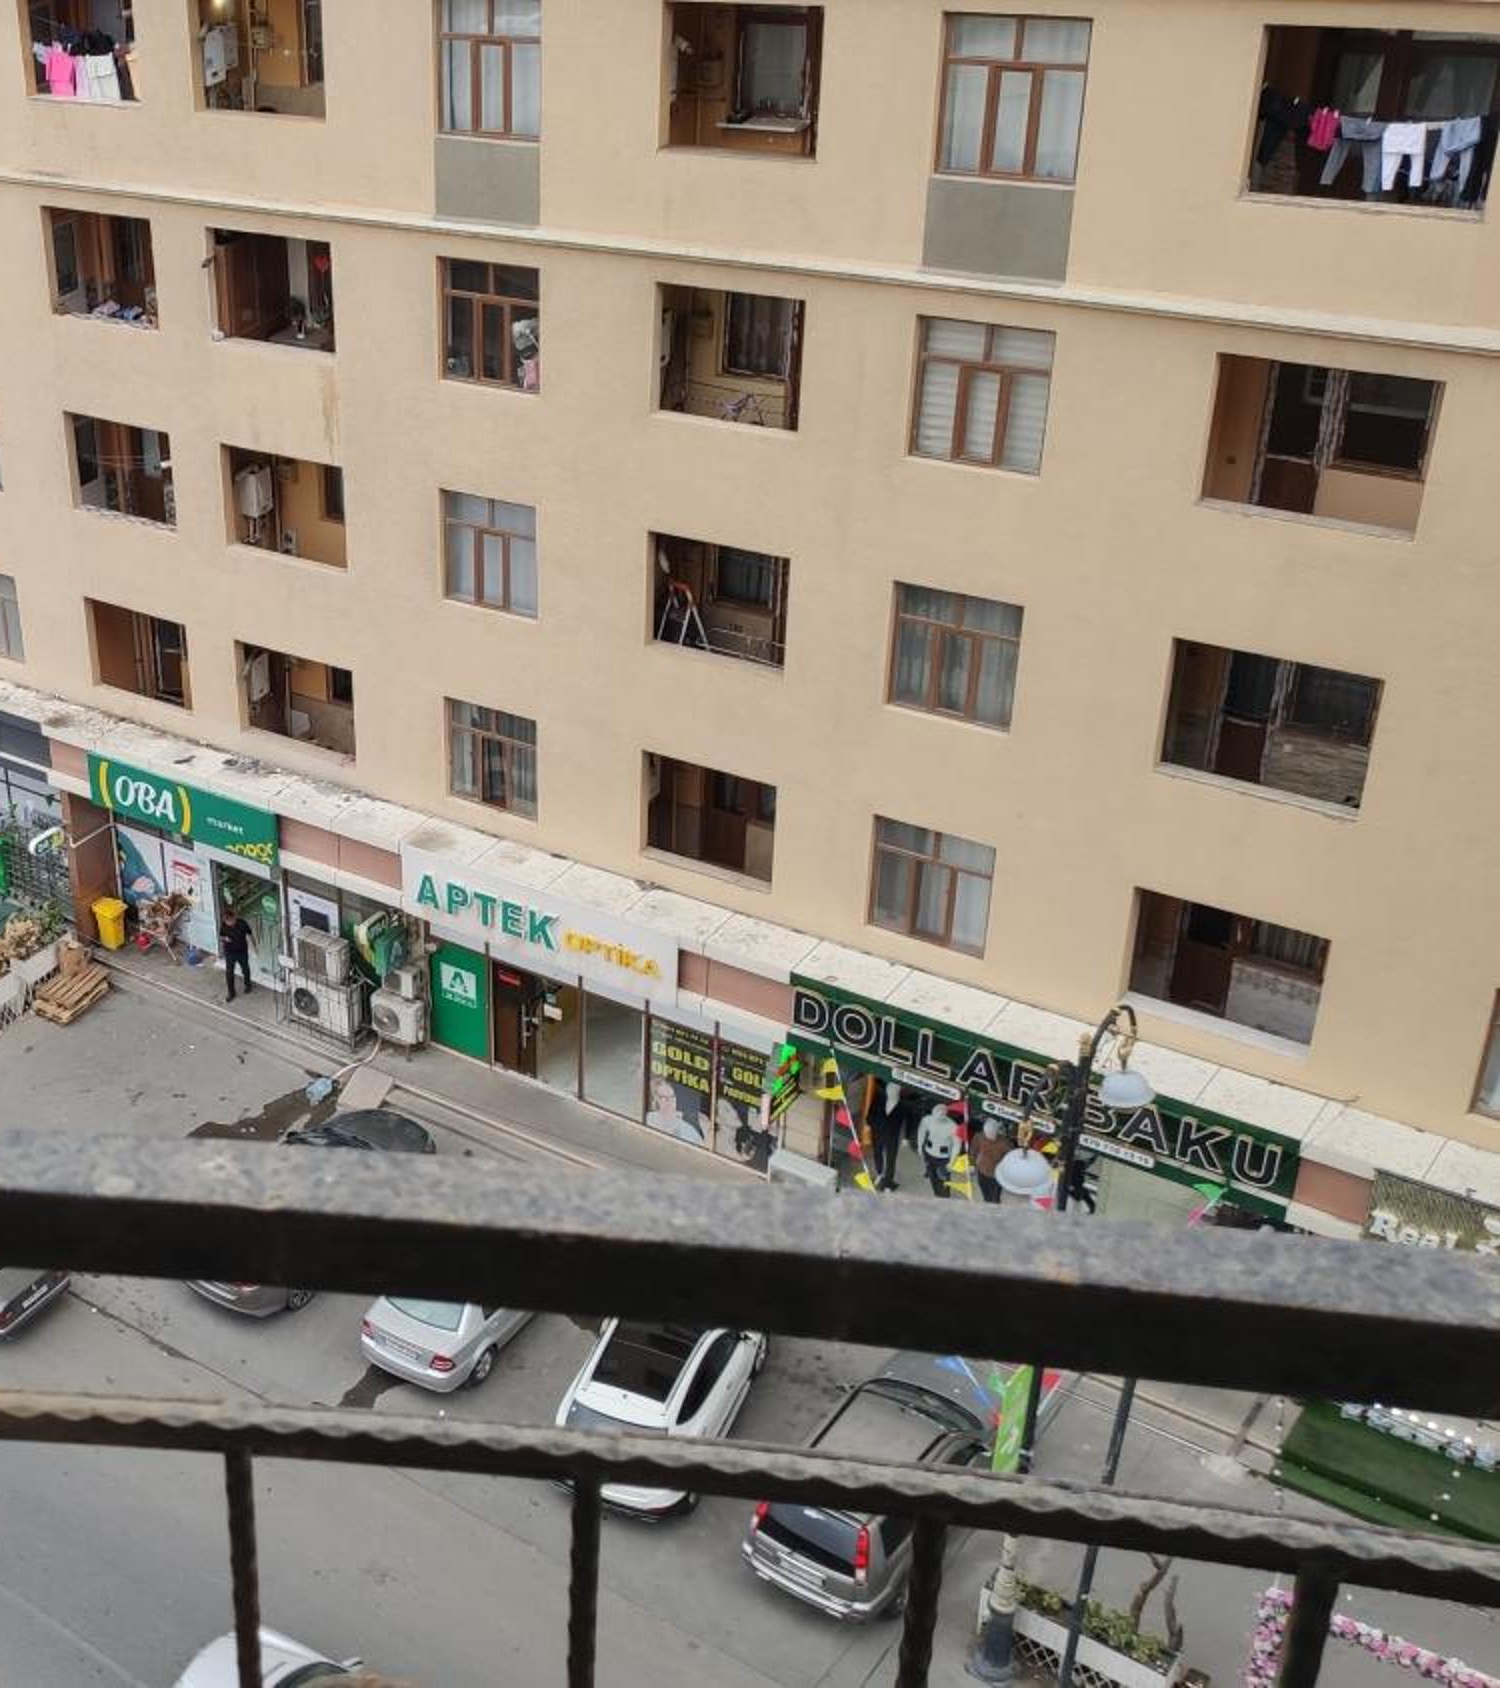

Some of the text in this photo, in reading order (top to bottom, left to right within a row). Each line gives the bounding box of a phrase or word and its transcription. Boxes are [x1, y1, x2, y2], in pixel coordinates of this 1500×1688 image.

[205, 816, 244, 836] market
[416, 874, 560, 951] APTEK
[651, 1041, 709, 1071] GOLD
[731, 1066, 766, 1089] GOL
